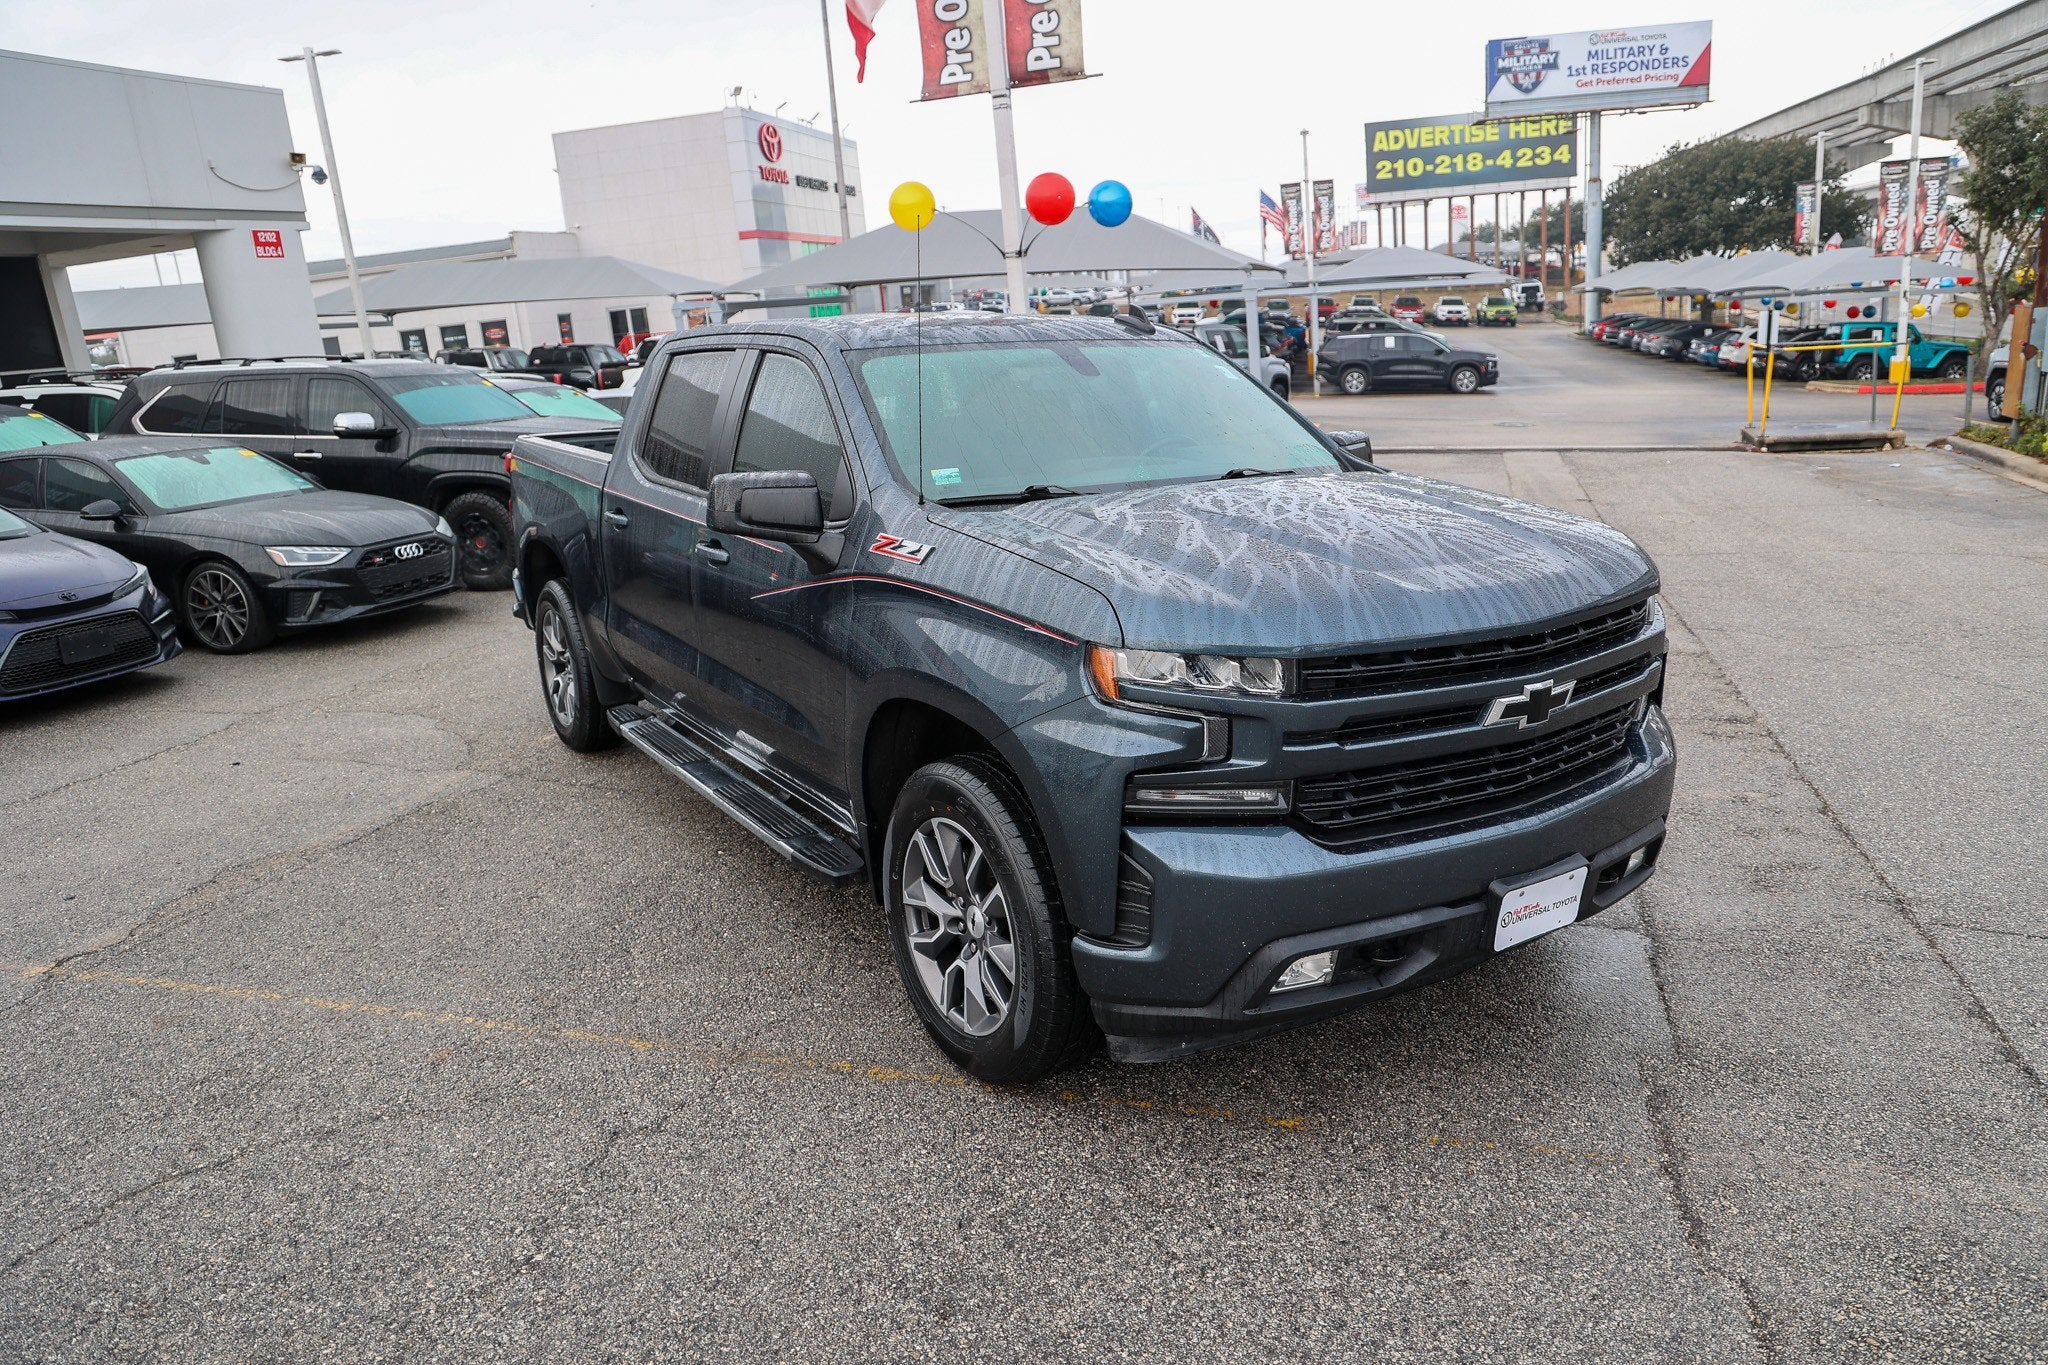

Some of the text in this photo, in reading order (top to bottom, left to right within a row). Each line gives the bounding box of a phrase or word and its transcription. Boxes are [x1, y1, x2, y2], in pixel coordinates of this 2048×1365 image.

[1026, 10, 1062, 72] Pre
[1601, 35, 1640, 44] UNIVERSAL
[1641, 33, 1668, 41] TOYOTA
[939, 26, 974, 86] Pre
[1497, 52, 1557, 69] MILITARY
[1587, 43, 1670, 62] MILITARY &
[1567, 55, 1690, 78] 1st RESPONDERS
[1576, 73, 1680, 88] Get Preferred Pricing
[1373, 114, 1574, 152] ADVERTISE HERE
[1375, 144, 1572, 180] 210-218-4234
[758, 165, 789, 185] TOYOTA
[1884, 182, 1900, 228] Owned
[1922, 180, 1940, 225] Owned
[1882, 229, 1898, 251] Pre
[1920, 226, 1936, 249] Pre
[1511, 903, 1551, 925] UNIVERSAL
[1552, 895, 1578, 910] TOYOTA
